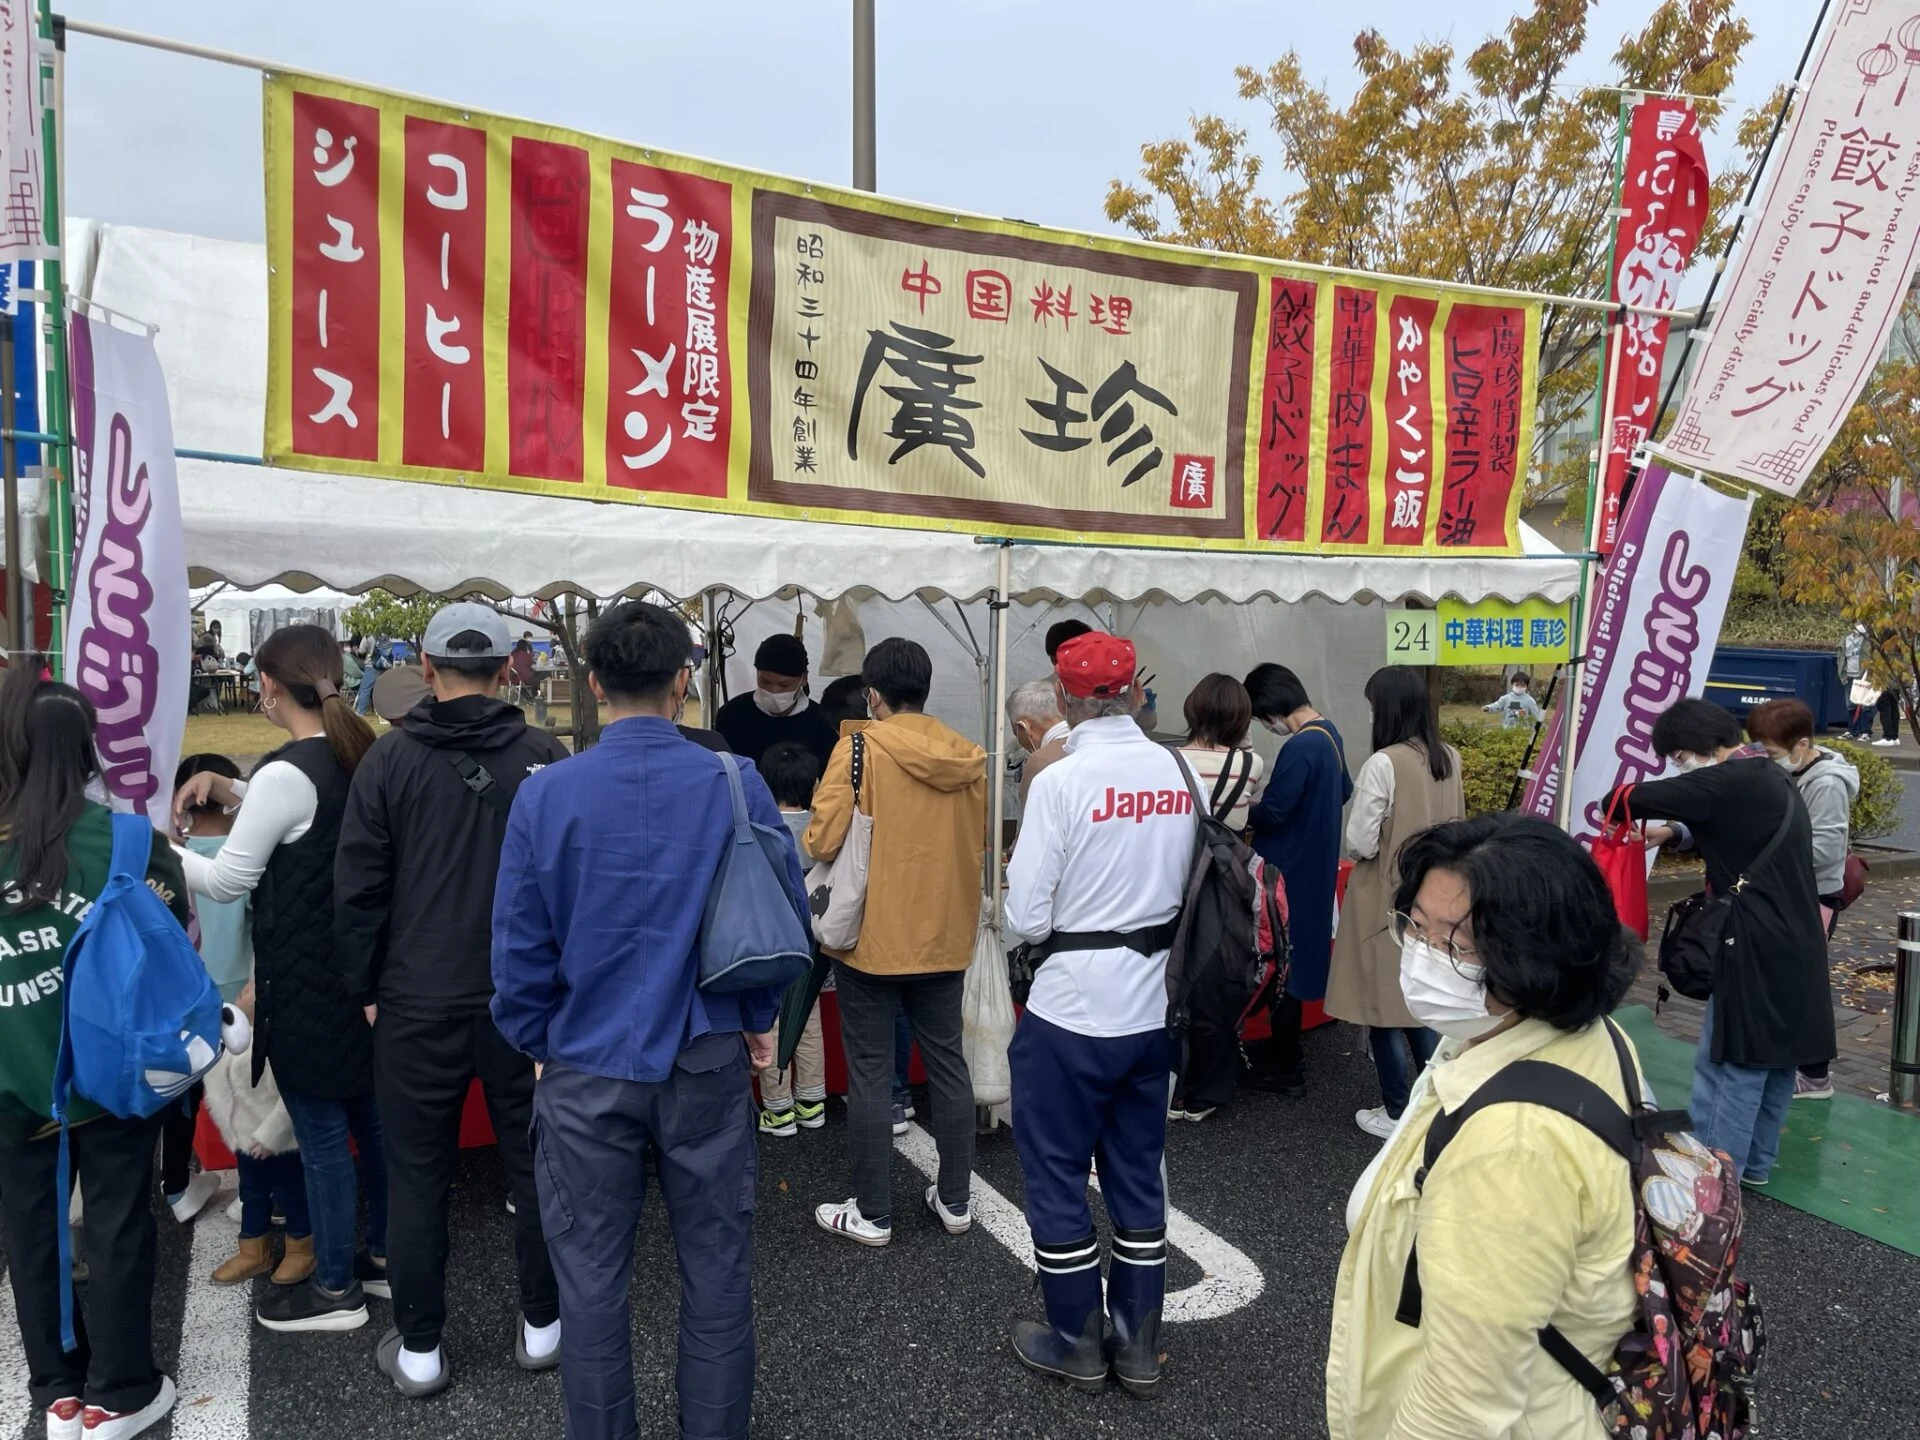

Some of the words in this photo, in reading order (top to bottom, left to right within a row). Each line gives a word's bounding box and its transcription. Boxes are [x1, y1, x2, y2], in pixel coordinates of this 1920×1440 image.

[1806, 119, 1837, 178] Please
[1781, 184, 1810, 232] enjoy
[1880, 208, 1903, 253] made
[308, 127, 365, 429] ジュース
[1731, 126, 1900, 417] 餃子ドッグ
[1771, 236, 1790, 266] our
[1866, 256, 1890, 285] hot
[425, 153, 471, 439] コーヒー
[622, 187, 676, 470] ラーメン
[901, 259, 1133, 335] 中国料理
[681, 218, 720, 442] 物産展限定
[792, 234, 824, 474] 昭和三十四年創業
[1705, 346, 1744, 405] dishes.
[1268, 288, 1313, 535] 餃子ドッグ
[1327, 293, 1372, 539] 中華肉まん
[1392, 316, 1426, 528] かやくご飯
[1441, 336, 1484, 545] 旨辛ラー油
[1792, 398, 1823, 433] food
[1597, 542, 1636, 641] Delicious!
[1394, 621, 1430, 651] 24
[1445, 618, 1524, 648] 中華料理
[1530, 618, 1567, 648] 廣珍
[1582, 645, 1607, 697] PURE
[1092, 787, 1193, 823] Japan
[1535, 763, 1559, 817] JUICE
